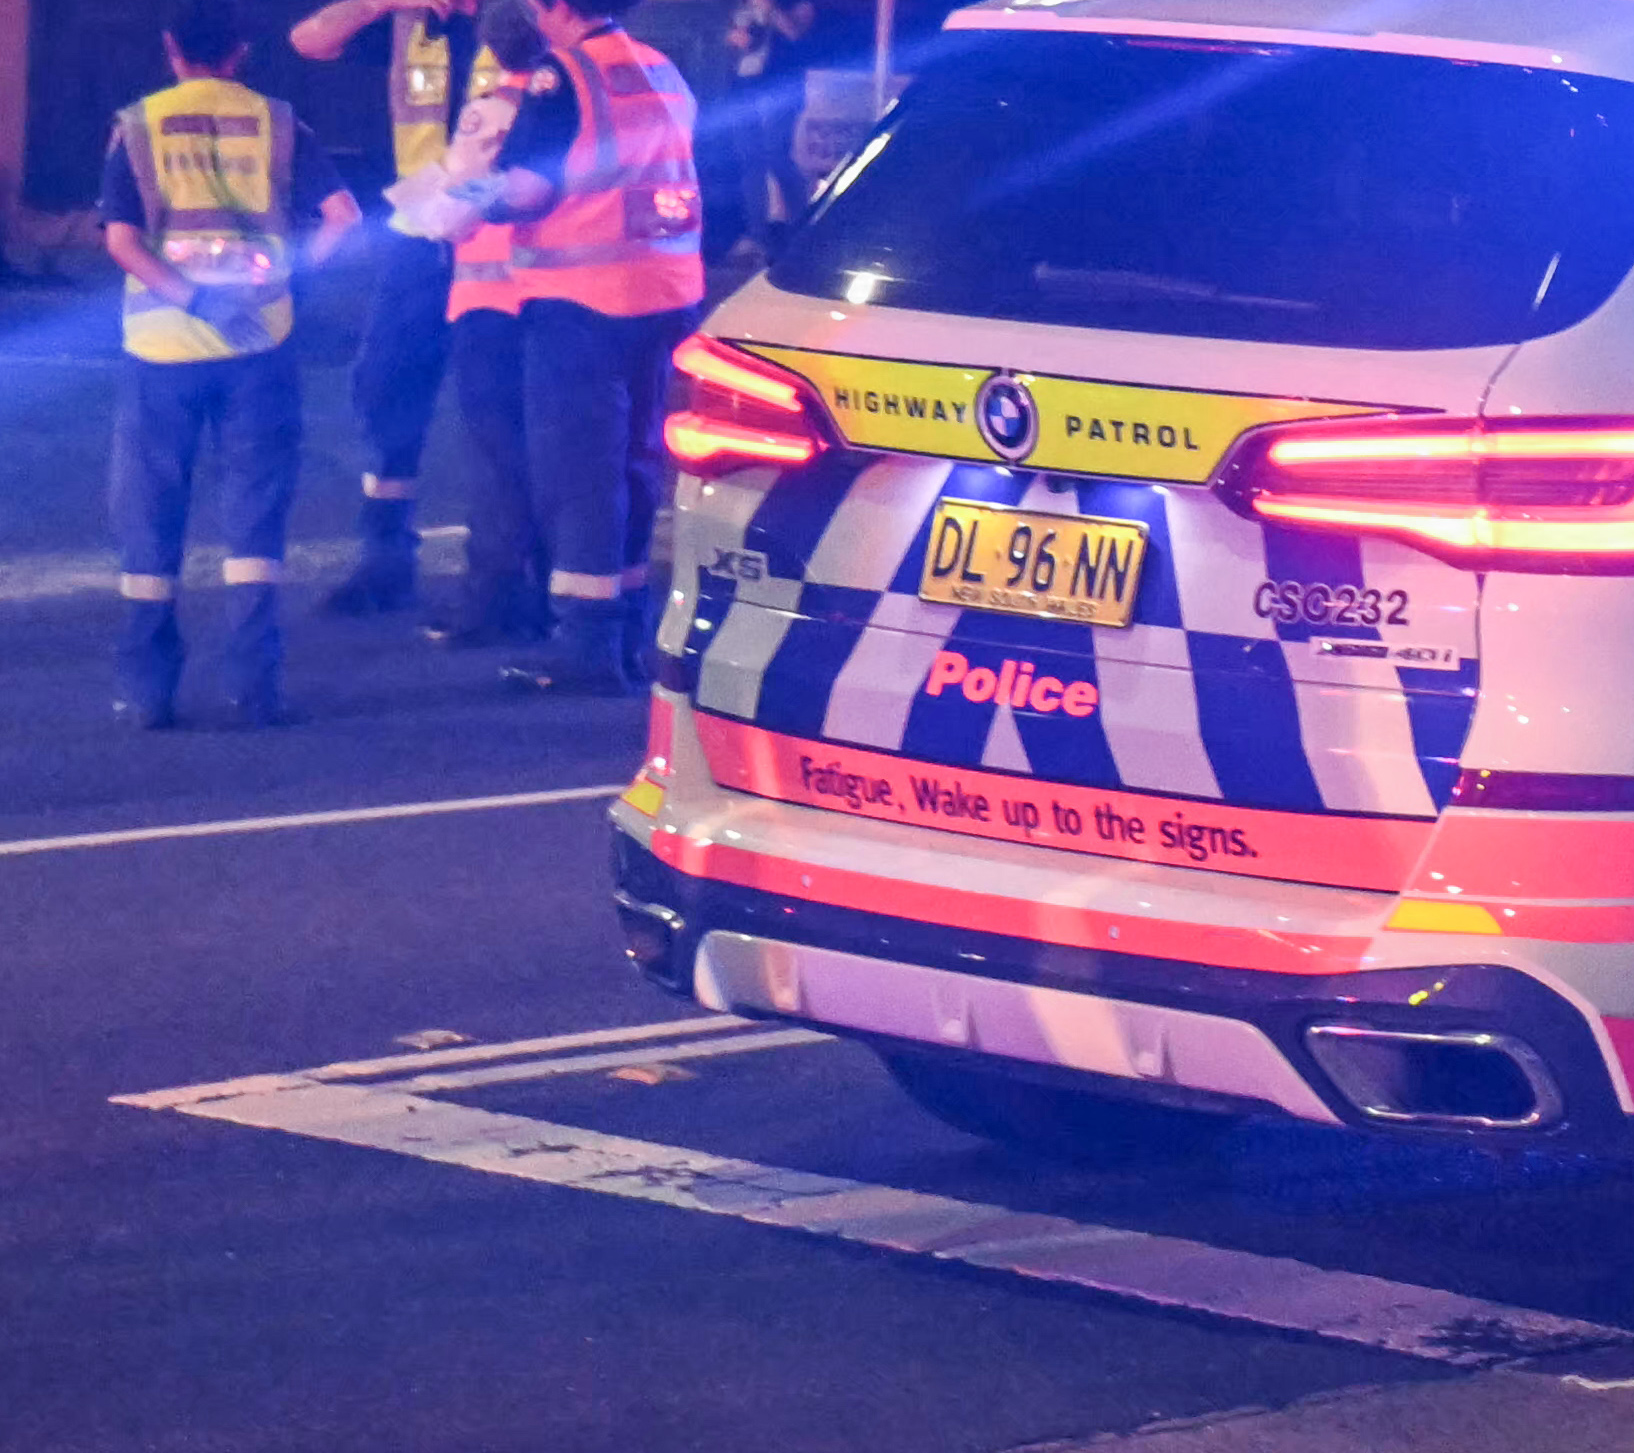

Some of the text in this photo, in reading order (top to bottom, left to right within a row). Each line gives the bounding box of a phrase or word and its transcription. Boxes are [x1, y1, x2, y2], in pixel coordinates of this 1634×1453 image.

[834, 386, 1200, 451] HIGHWAY PATROL
[932, 516, 1134, 604] DL 96 NN
[926, 649, 1099, 719] Police
[909, 775, 992, 824] Wake
[1003, 799, 1040, 841] up
[1053, 800, 1082, 836] to
[1095, 802, 1146, 845] the
[1159, 811, 1260, 861] signs.
